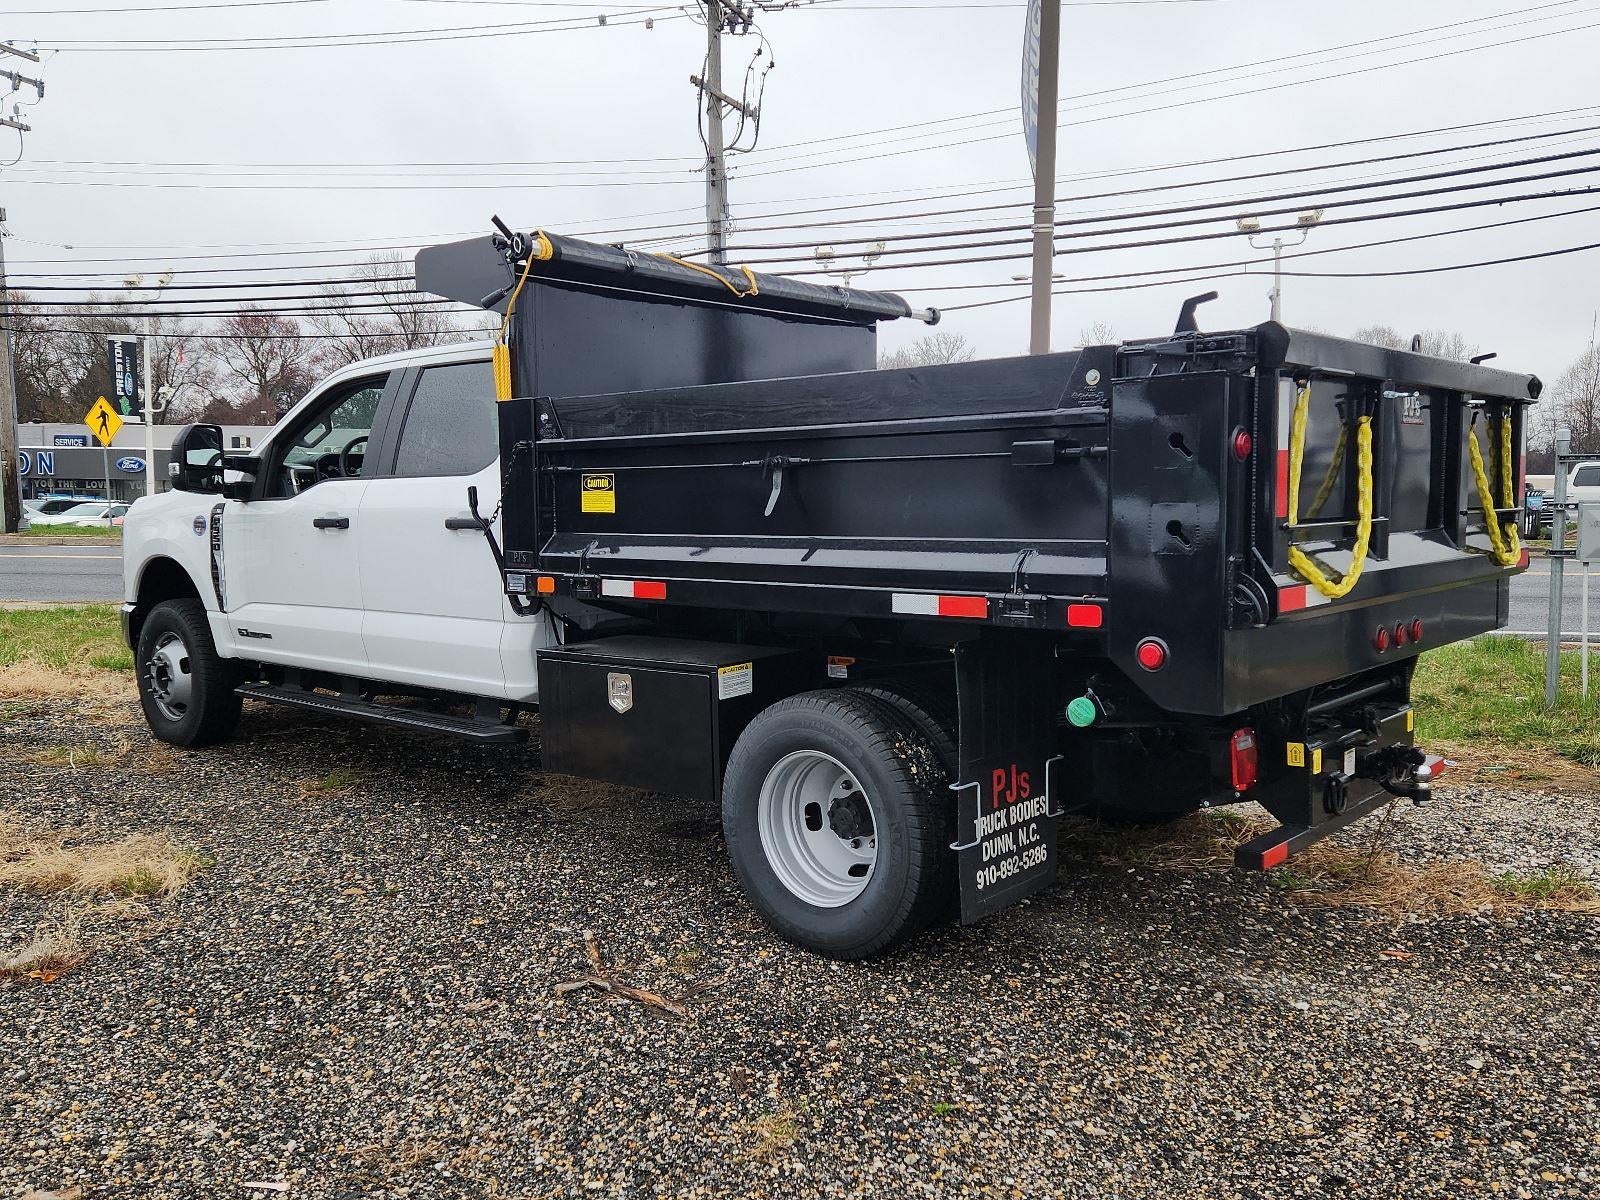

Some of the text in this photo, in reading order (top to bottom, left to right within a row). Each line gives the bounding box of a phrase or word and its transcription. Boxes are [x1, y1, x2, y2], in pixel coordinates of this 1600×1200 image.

[1029, 0, 1041, 127] TRUC
[114, 340, 124, 395] PRESTON
[54, 438, 83, 447] SERVICE
[34, 480, 54, 488] YOU
[587, 479, 609, 488] CAUTION
[974, 795, 1046, 839] TRUCK BODIES
[982, 822, 1041, 862] DUNN, N.C.
[976, 843, 1048, 890] 910-892-5286
